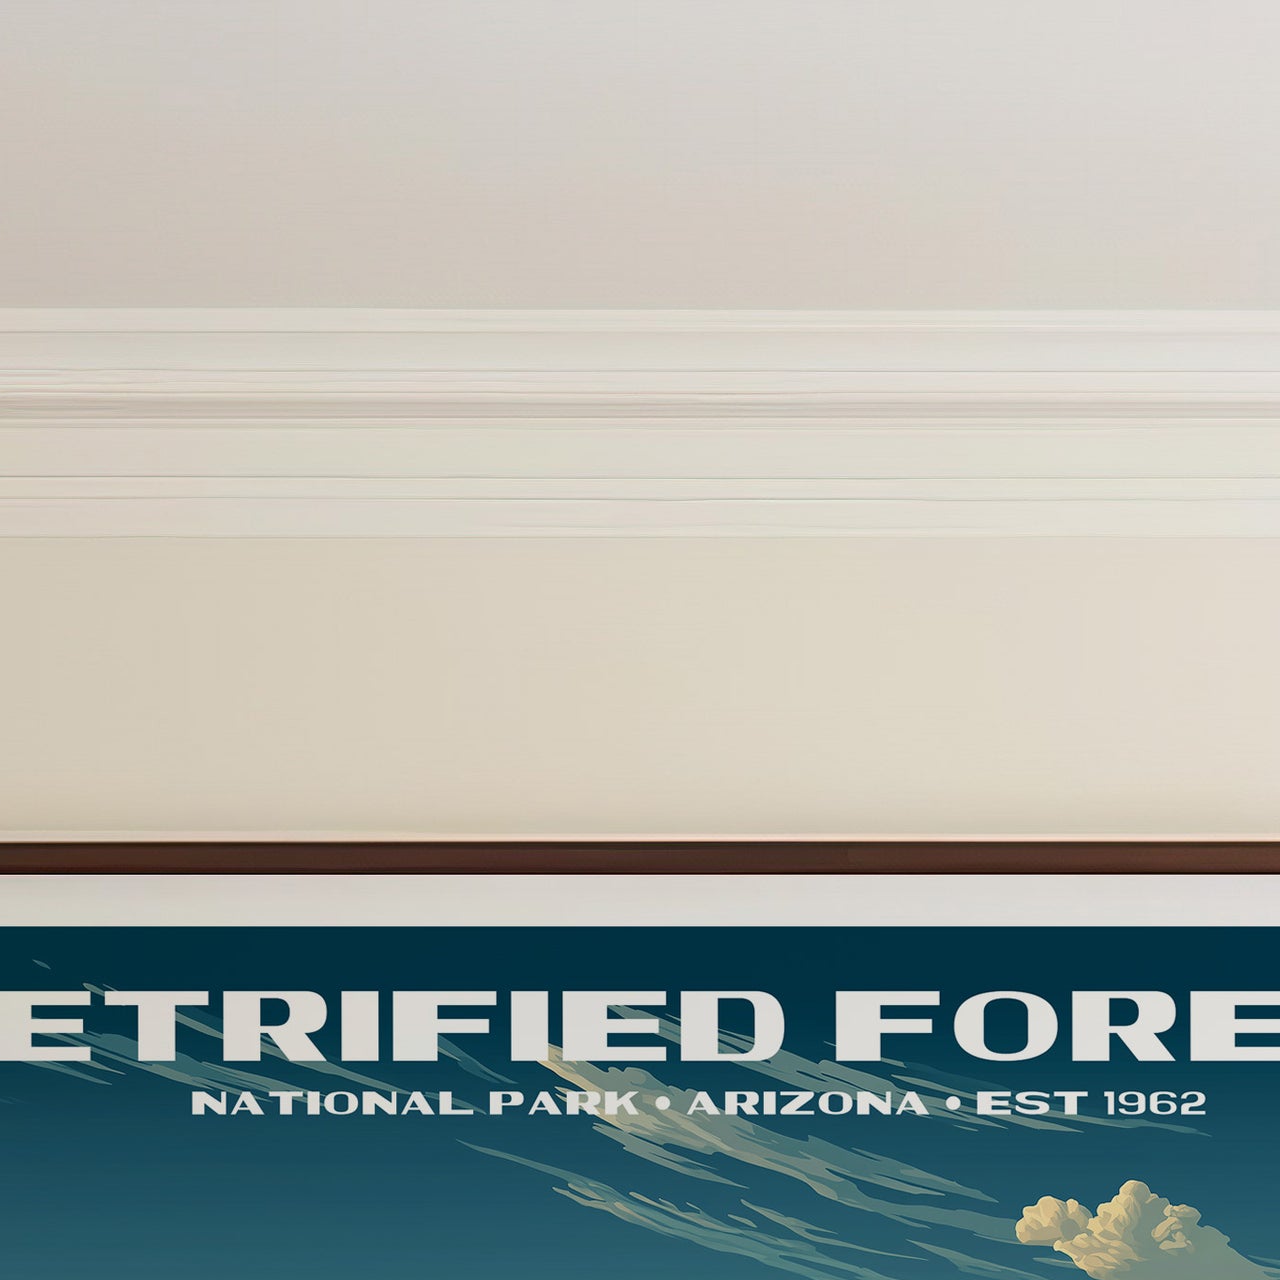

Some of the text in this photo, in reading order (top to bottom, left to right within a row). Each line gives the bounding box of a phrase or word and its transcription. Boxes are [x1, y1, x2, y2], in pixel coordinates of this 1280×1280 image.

[192, 1090, 1206, 1115] NATIONAL PARK ARIZONA EST 1962
